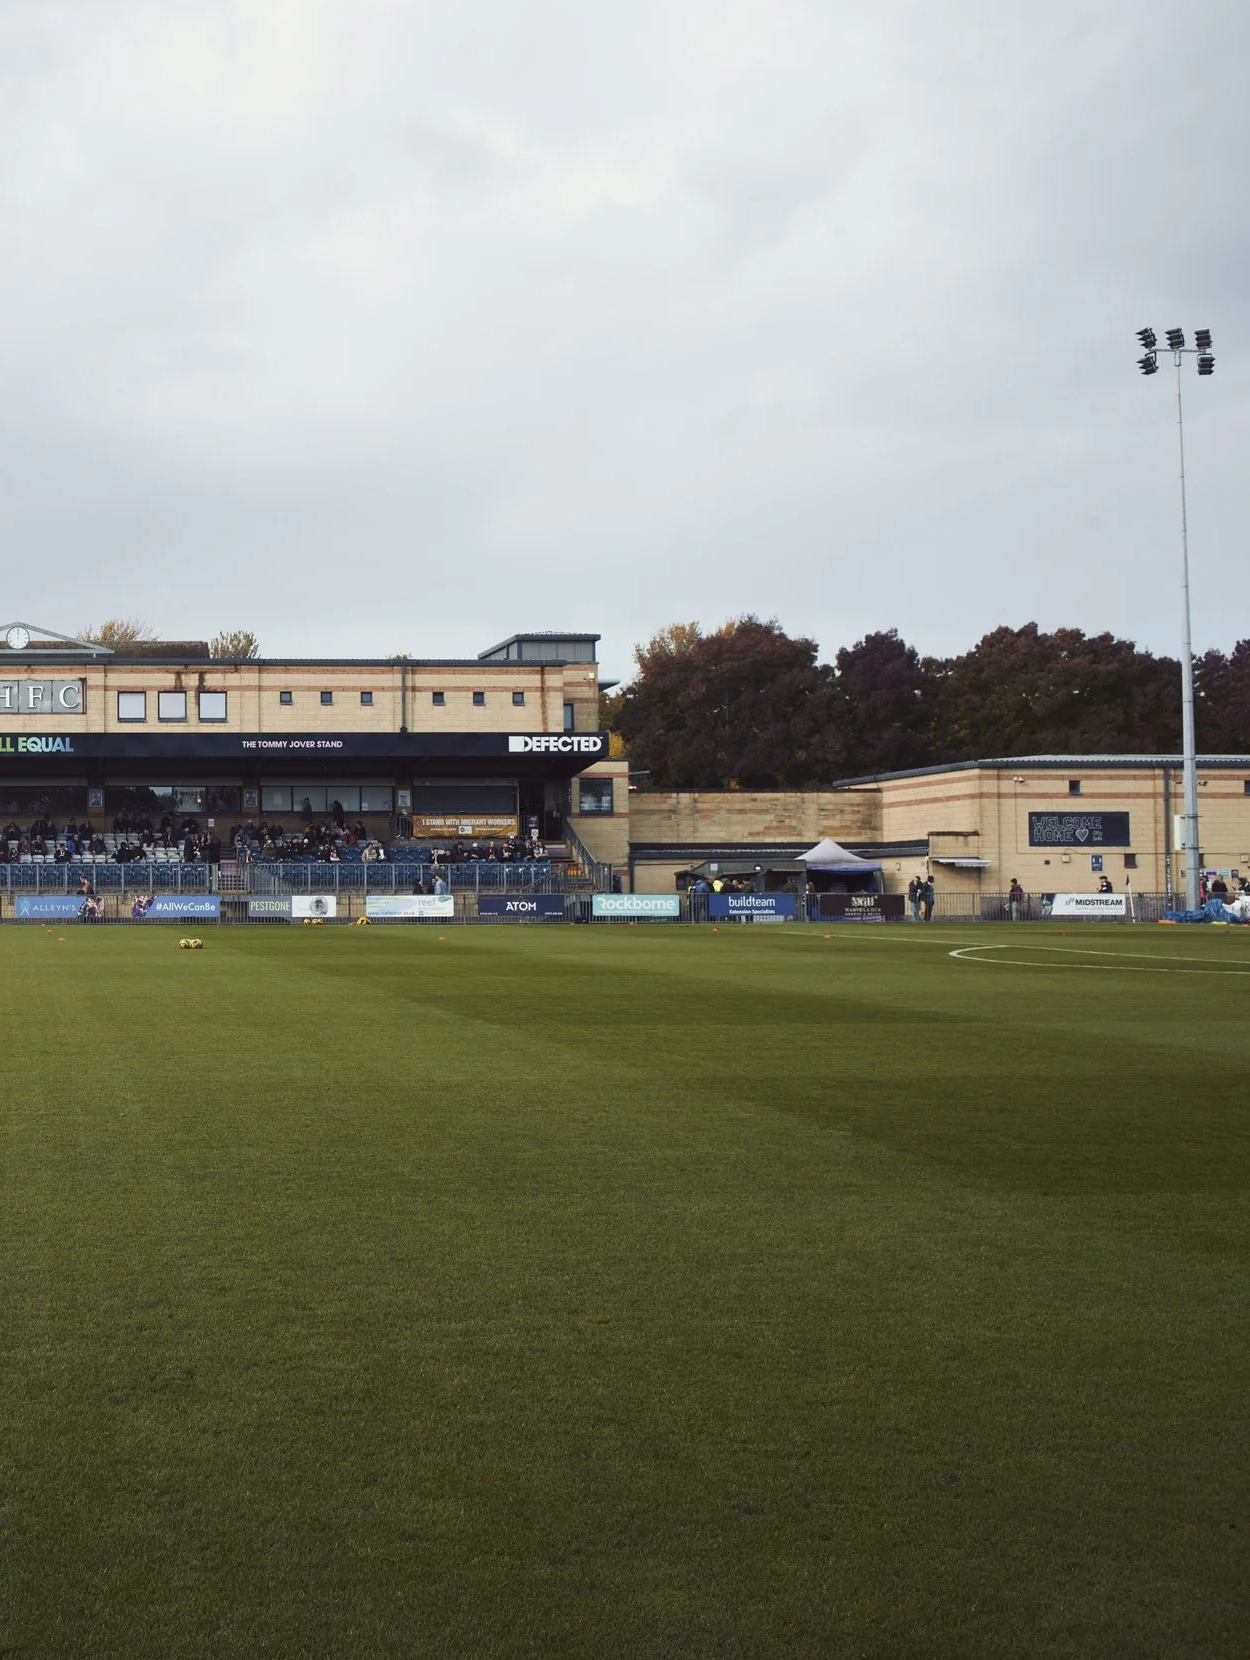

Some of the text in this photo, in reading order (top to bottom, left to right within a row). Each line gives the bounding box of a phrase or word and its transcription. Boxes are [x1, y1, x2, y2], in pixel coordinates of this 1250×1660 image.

[18, 736, 74, 752] EQUAL
[508, 736, 602, 752] DEFECTED
[426, 818, 444, 826] STAND
[446, 818, 460, 826] WITH
[460, 818, 486, 826] MIGRANT
[487, 818, 516, 826] WORKERS
[1032, 816, 1102, 829] WELCOME
[1034, 829, 1074, 842] HOME
[250, 901, 290, 911] PESTGONE
[506, 902, 537, 910] ATOM
[597, 896, 675, 910] Rockborne
[728, 896, 776, 906] buildteam
[156, 903, 216, 911] #AllWeCanBe
